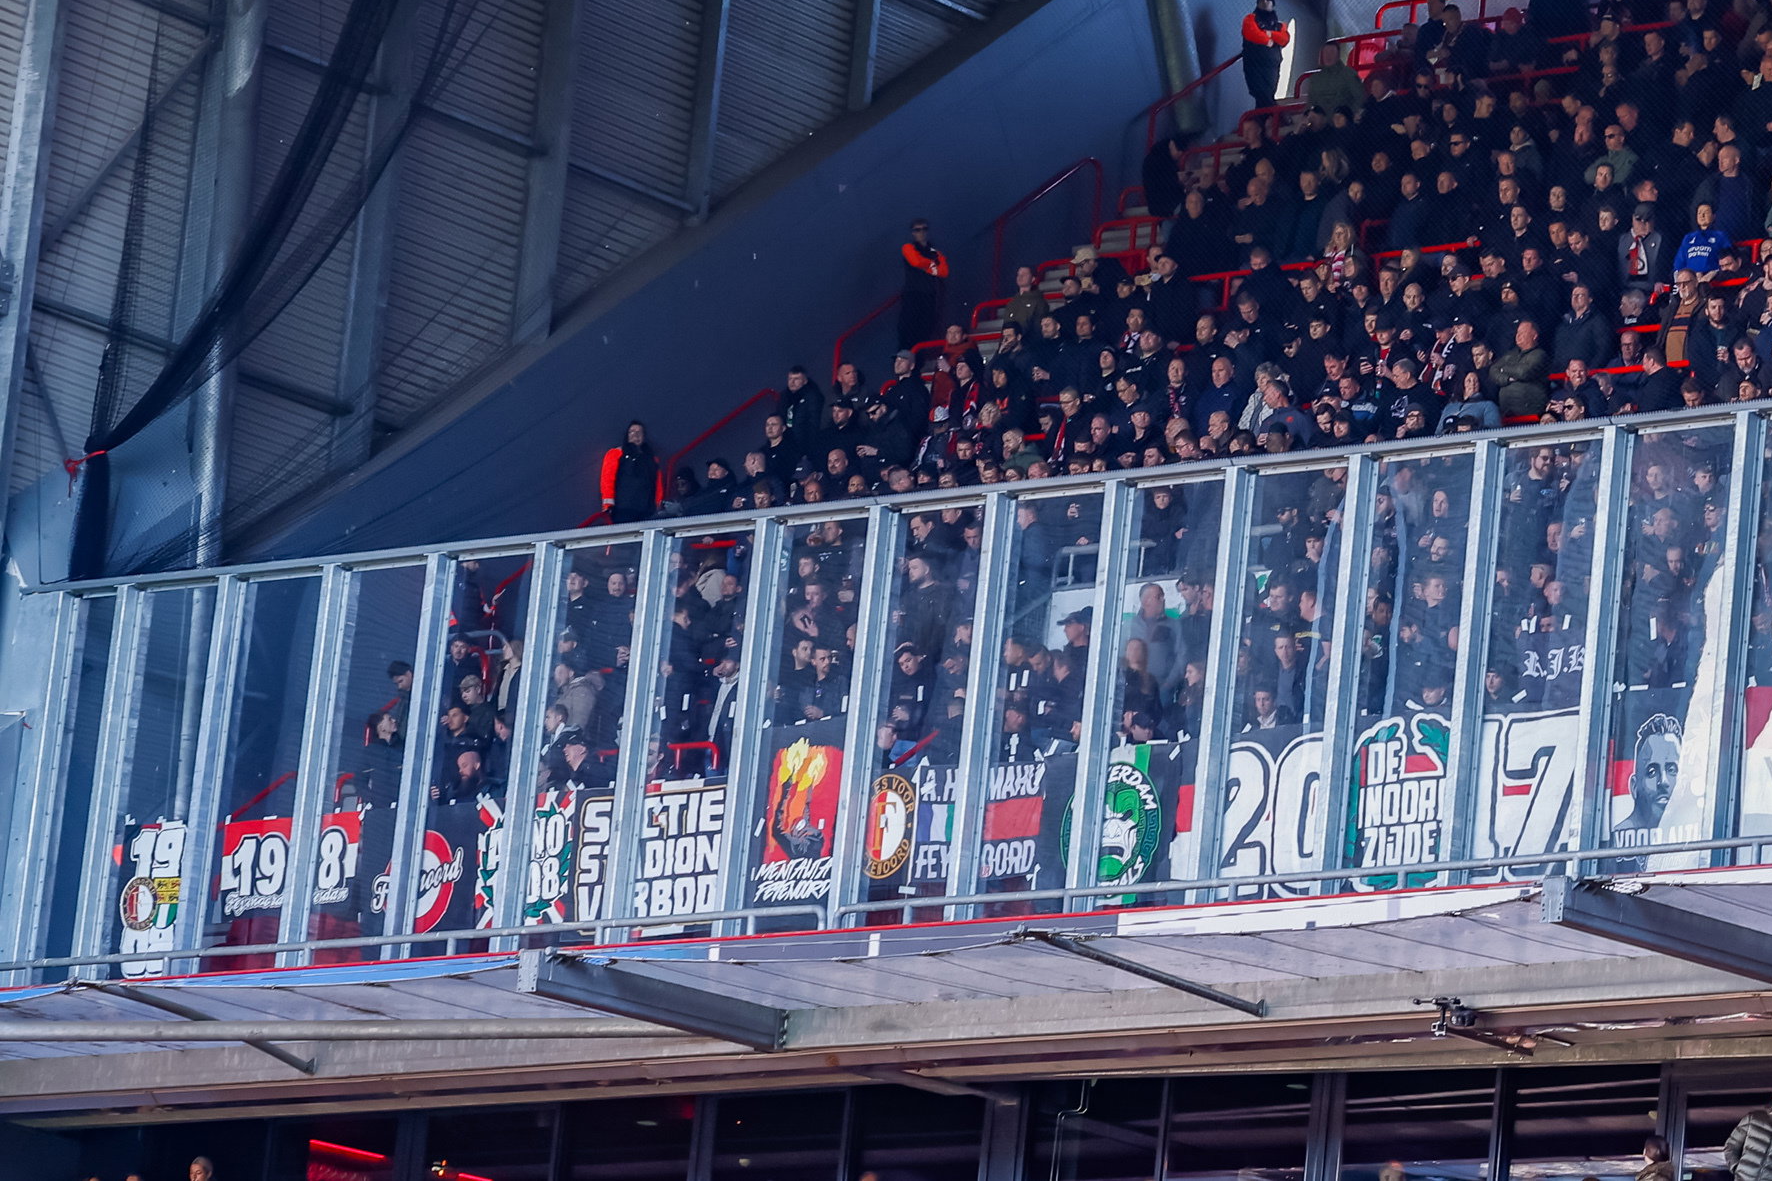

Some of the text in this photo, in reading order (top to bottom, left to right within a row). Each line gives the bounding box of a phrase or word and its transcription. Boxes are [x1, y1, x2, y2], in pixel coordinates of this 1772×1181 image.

[1367, 740, 1402, 784] DE
[583, 789, 725, 843] SCTIE
[1364, 777, 1445, 828] NOOR
[132, 827, 188, 878] 19
[578, 833, 722, 884] SDION
[577, 873, 718, 922] VRBOD
